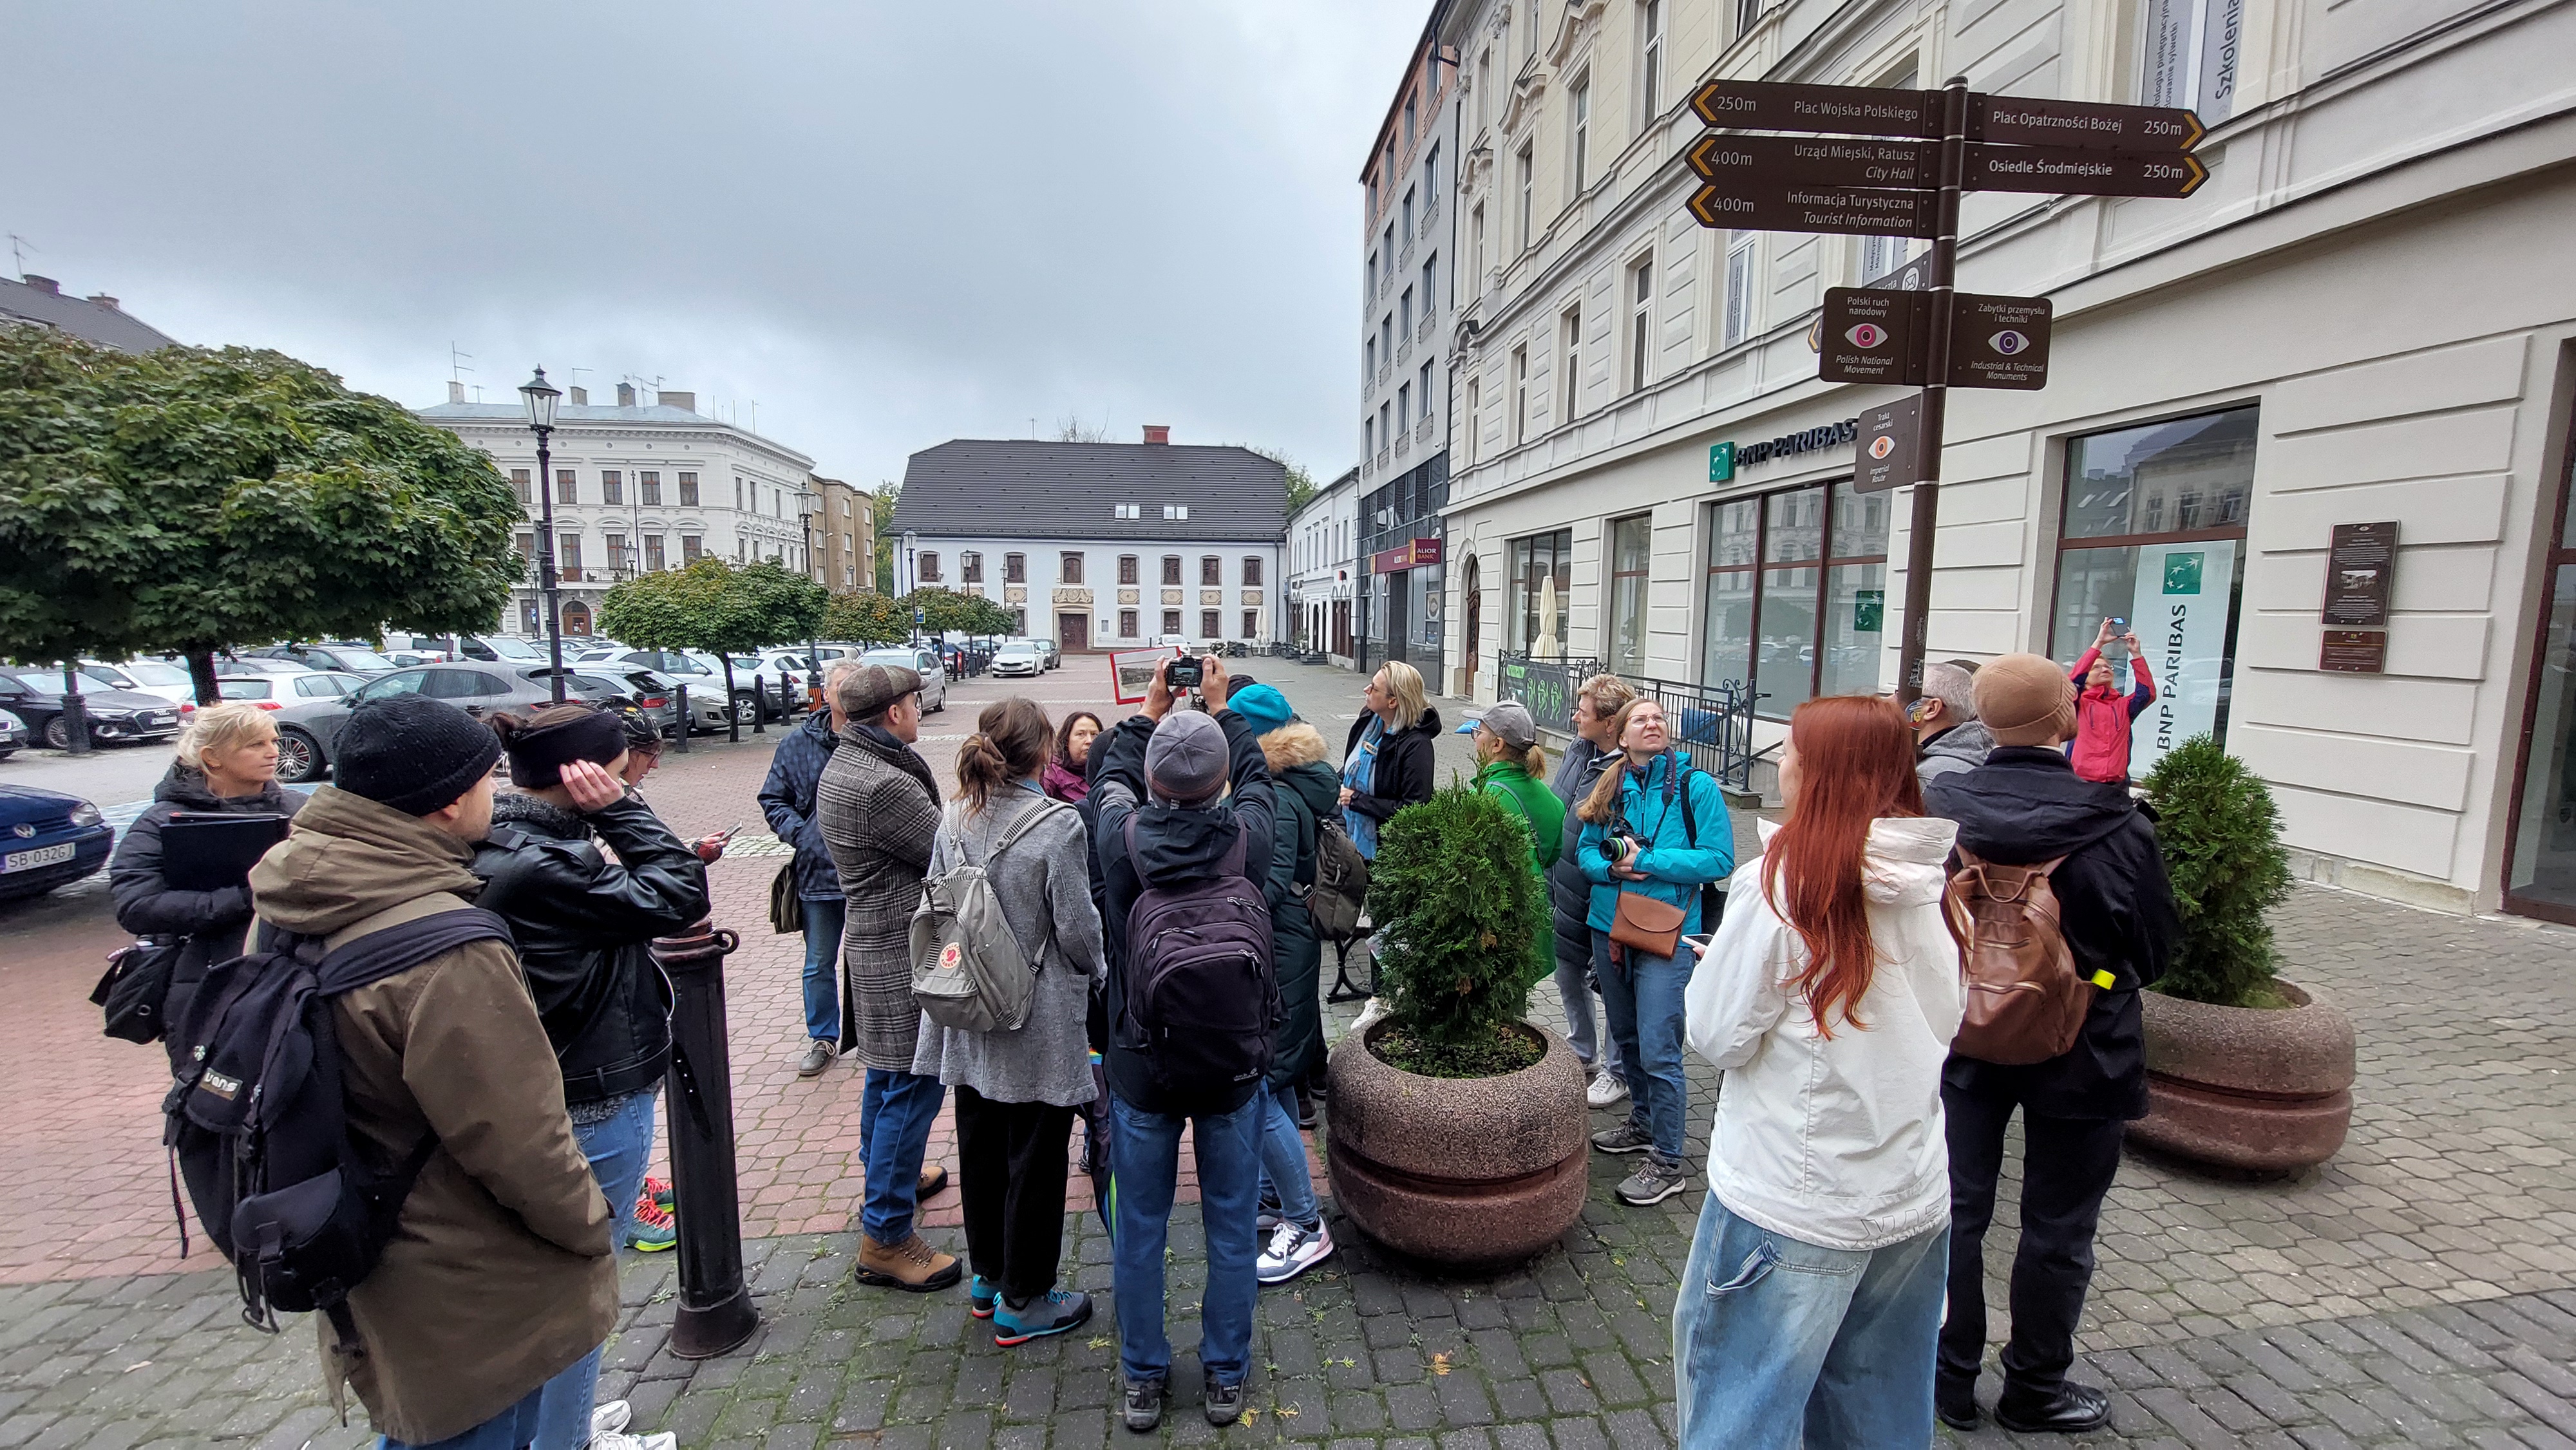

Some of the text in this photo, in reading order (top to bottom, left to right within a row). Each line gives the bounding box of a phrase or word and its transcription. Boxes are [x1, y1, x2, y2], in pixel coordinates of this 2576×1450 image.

[2168, 22, 2178, 65] sylwetki
[2215, 0, 2240, 100] Szkolenia
[2154, 70, 2164, 108] tologia
[1717, 95, 1757, 111] 250m
[1794, 101, 1918, 122] Plac Wojska Polskiego
[1993, 111, 2123, 135] Plac Opatrzności Bożej
[1710, 150, 1753, 166] 400m
[1794, 144, 1916, 161] Urząd Miejski, Ratusz
[1865, 165, 1915, 180] City Hall
[1989, 159, 2113, 178] Osiedle Środmiejskie
[1713, 196, 1755, 213] 400m
[1786, 191, 1915, 211] Informacja Turystyczna
[1803, 211, 1913, 229] Tourist Information
[1846, 296, 1890, 307] Polski ruch
[1978, 303, 2007, 315] Zabytki
[1848, 307, 1888, 318] narodowy
[1994, 314, 2029, 323] i techniki
[1835, 355, 1893, 366] Polish National
[1971, 361, 2045, 373] Industrial & Technical
[1844, 364, 1884, 375] Movement
[1986, 371, 2029, 381] Monuments
[1877, 411, 1891, 422] Trakt
[1873, 419, 1894, 432] cesarski
[1735, 418, 1859, 467] BNP PARIBAS
[1869, 464, 1890, 476] Imperial
[1871, 474, 1887, 484] Route
[917, 607, 923, 617] P
[2156, 603, 2187, 751] BNP PARIBAS
[8, 844, 73, 868] SB 032GJ
